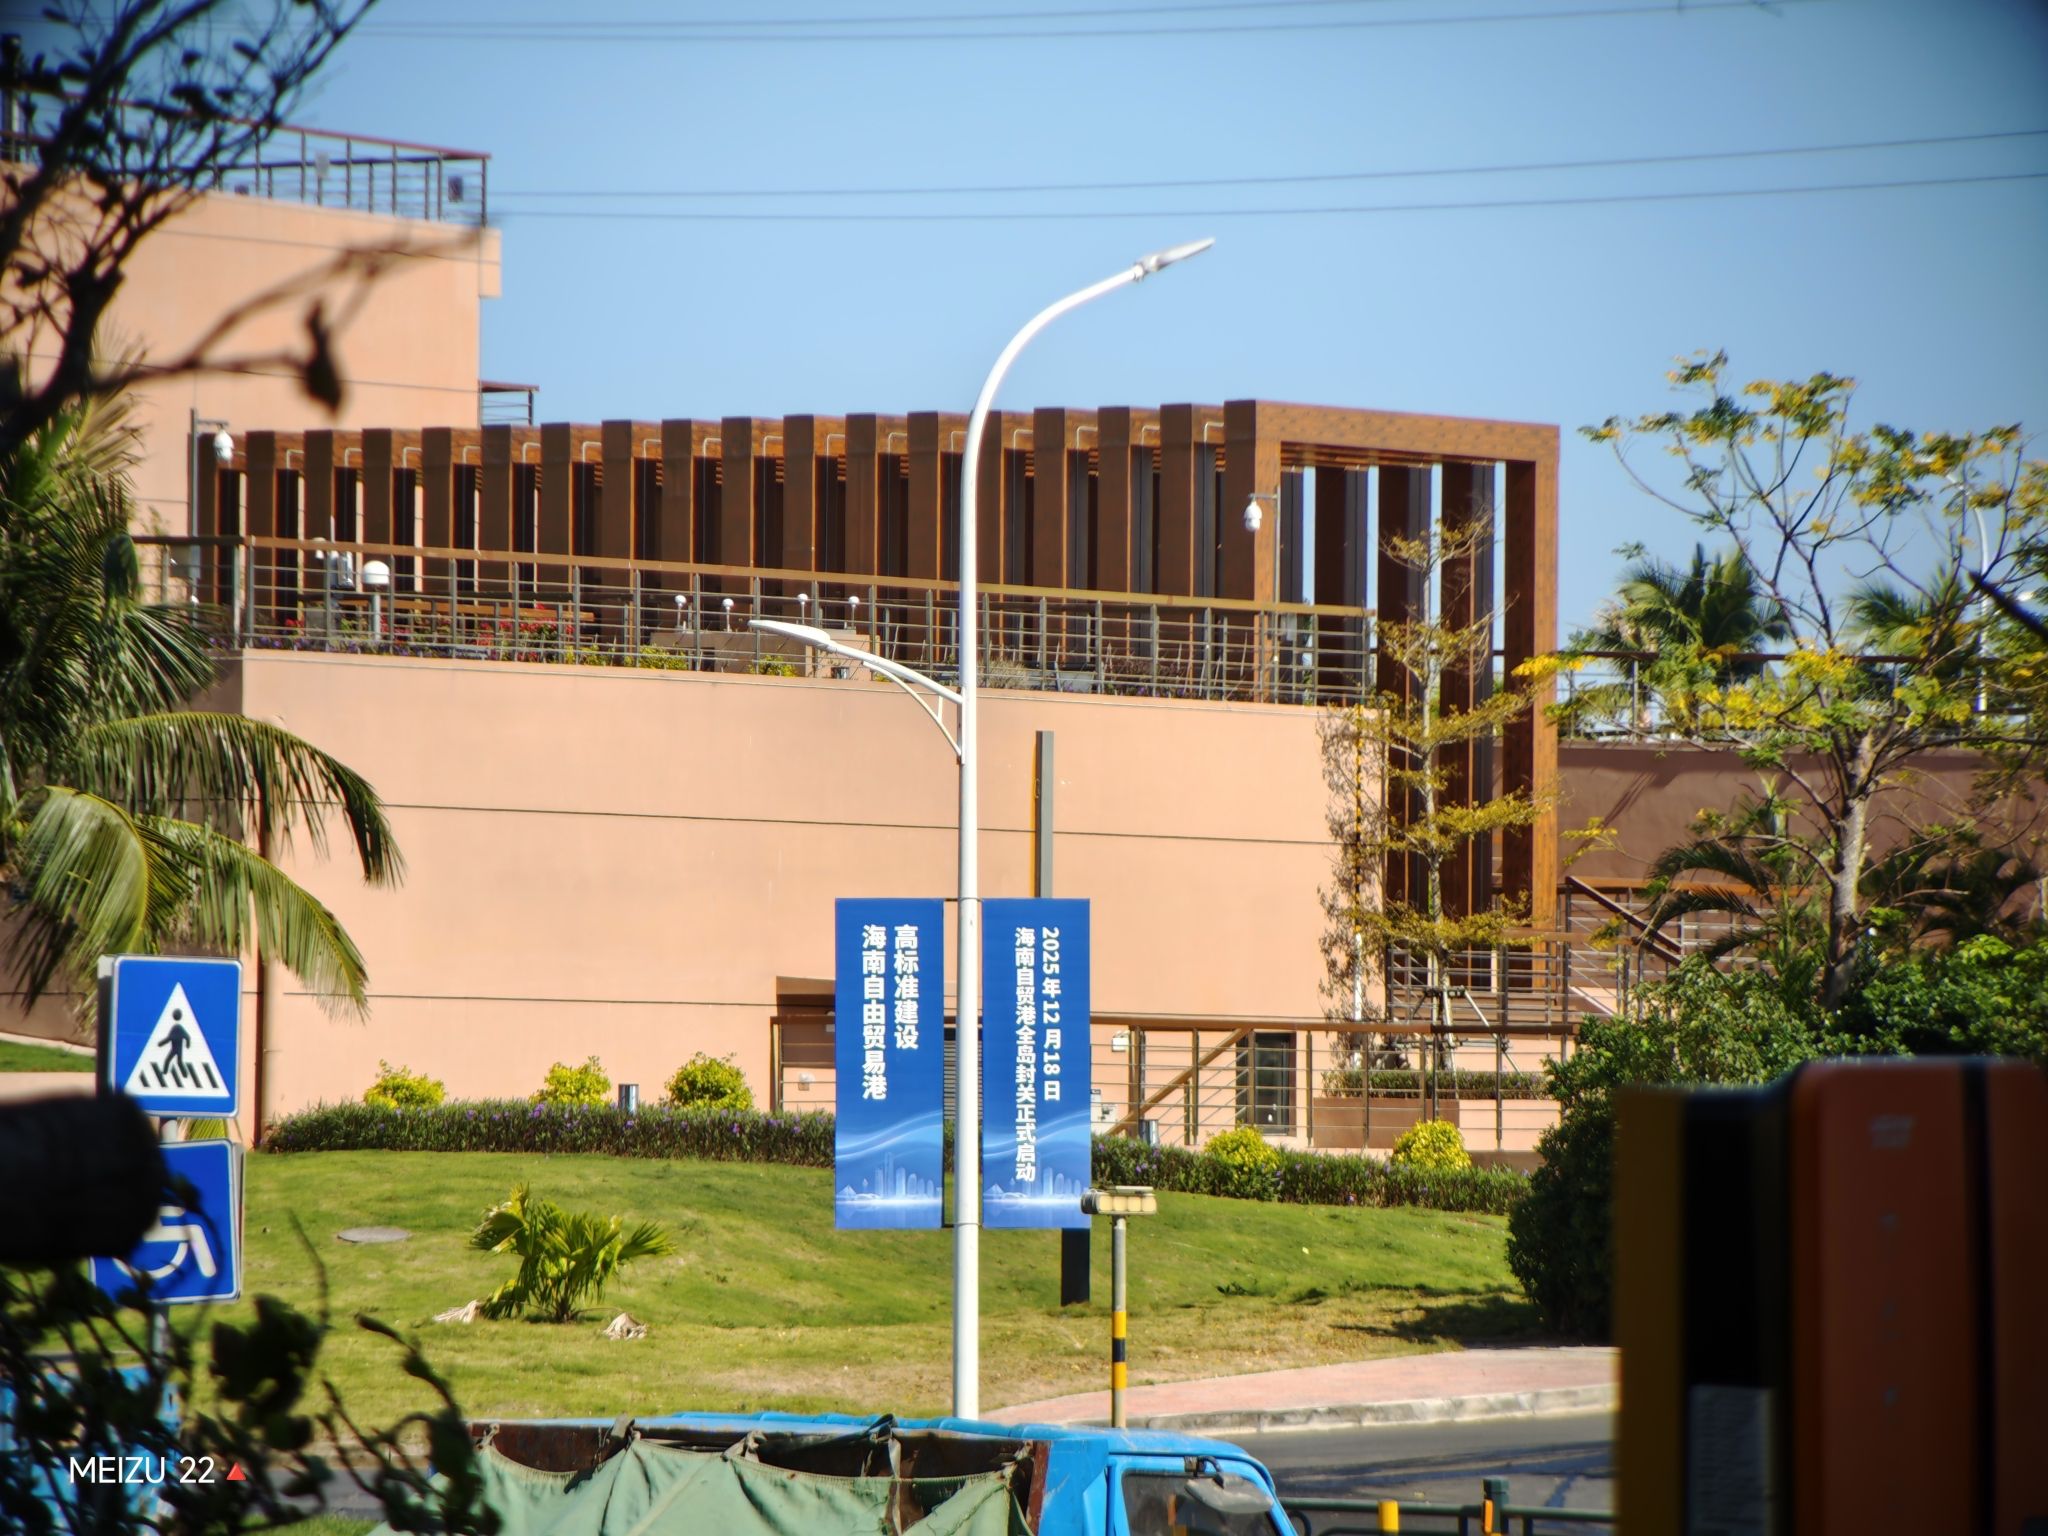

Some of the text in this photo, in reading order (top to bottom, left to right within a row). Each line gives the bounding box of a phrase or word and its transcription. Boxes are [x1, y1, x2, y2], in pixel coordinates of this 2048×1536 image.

[862, 924, 887, 1100] 海南自由贸易港
[894, 924, 919, 1049] 高标准建设
[1015, 927, 1036, 1182] 海南自贸港全岛封关正式启动
[1042, 927, 1061, 1101] 2025年12月18日
